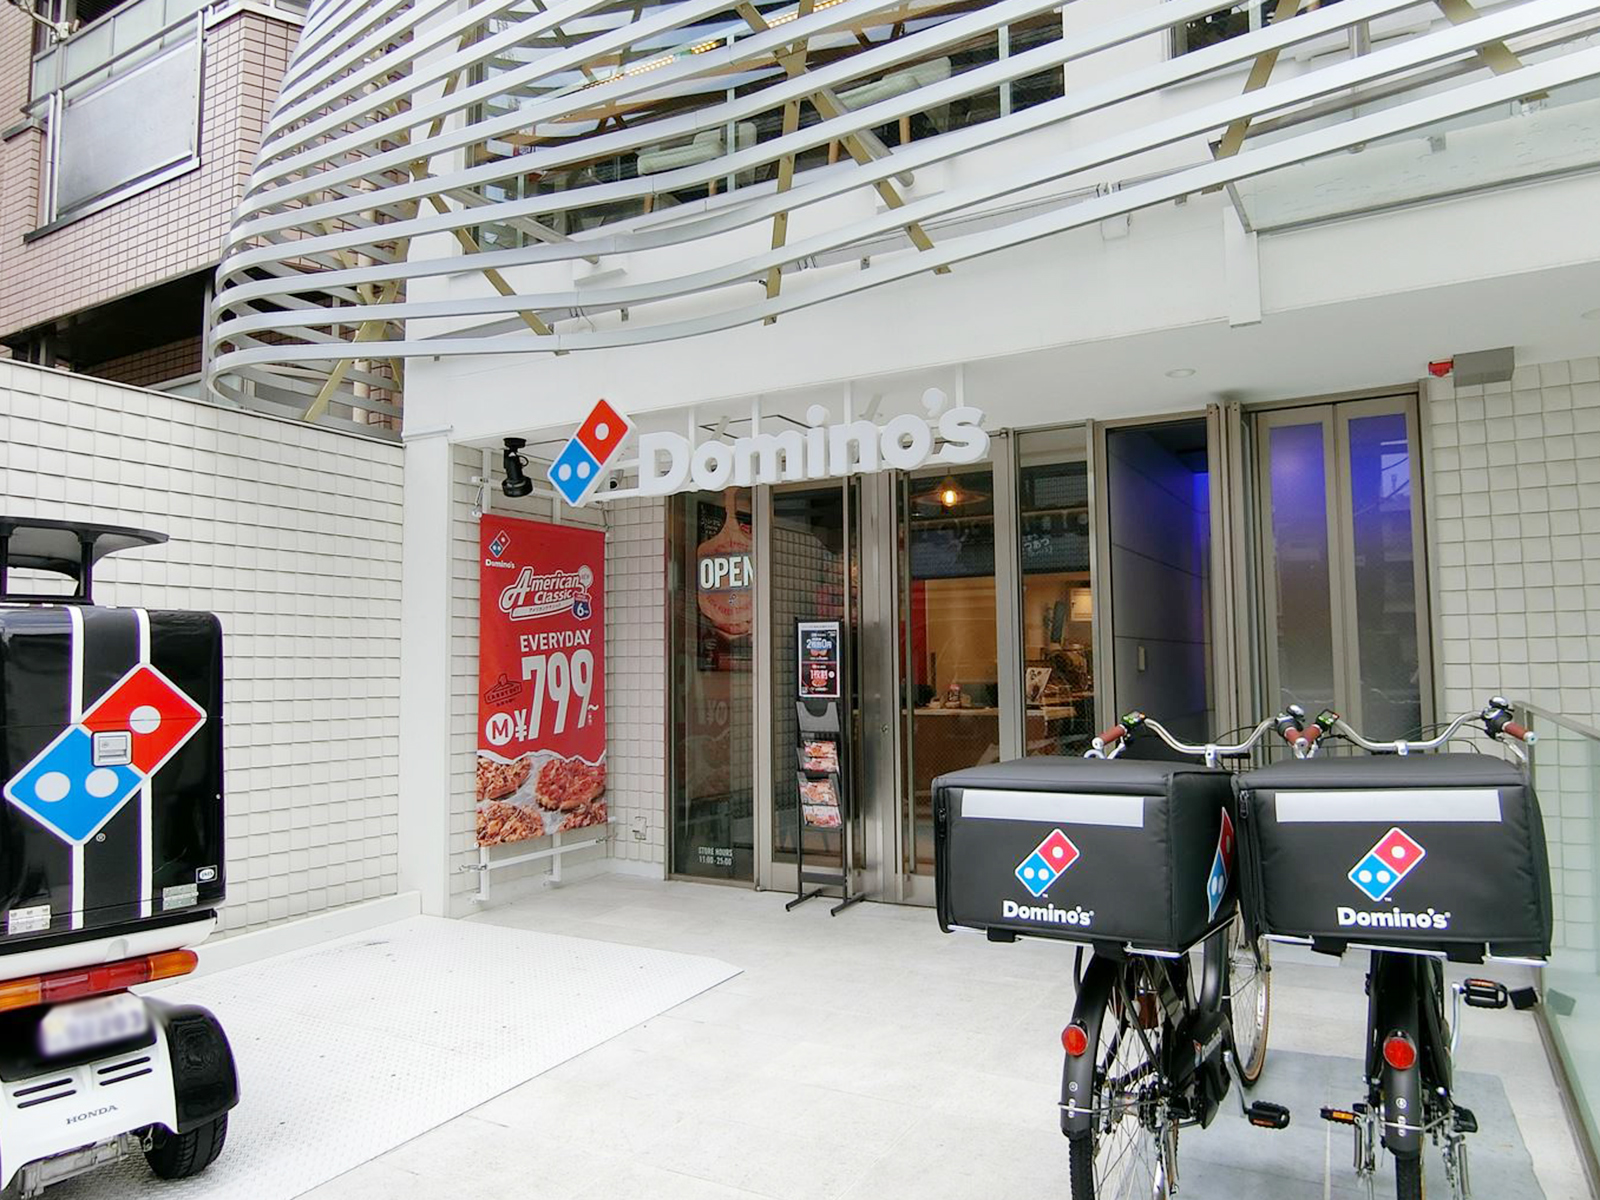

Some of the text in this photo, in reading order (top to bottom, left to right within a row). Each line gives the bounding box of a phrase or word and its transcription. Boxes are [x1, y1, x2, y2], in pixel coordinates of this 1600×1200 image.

[638, 387, 990, 497] Domino's
[485, 558, 515, 569] Domino's
[700, 556, 754, 590] OPEN
[501, 568, 580, 612] American
[534, 589, 572, 604] Classic
[520, 629, 592, 652] EVERYDAY
[1002, 900, 1091, 926] Domino's
[1337, 906, 1448, 929] Domino's
[66, 1105, 118, 1125] HONDA
